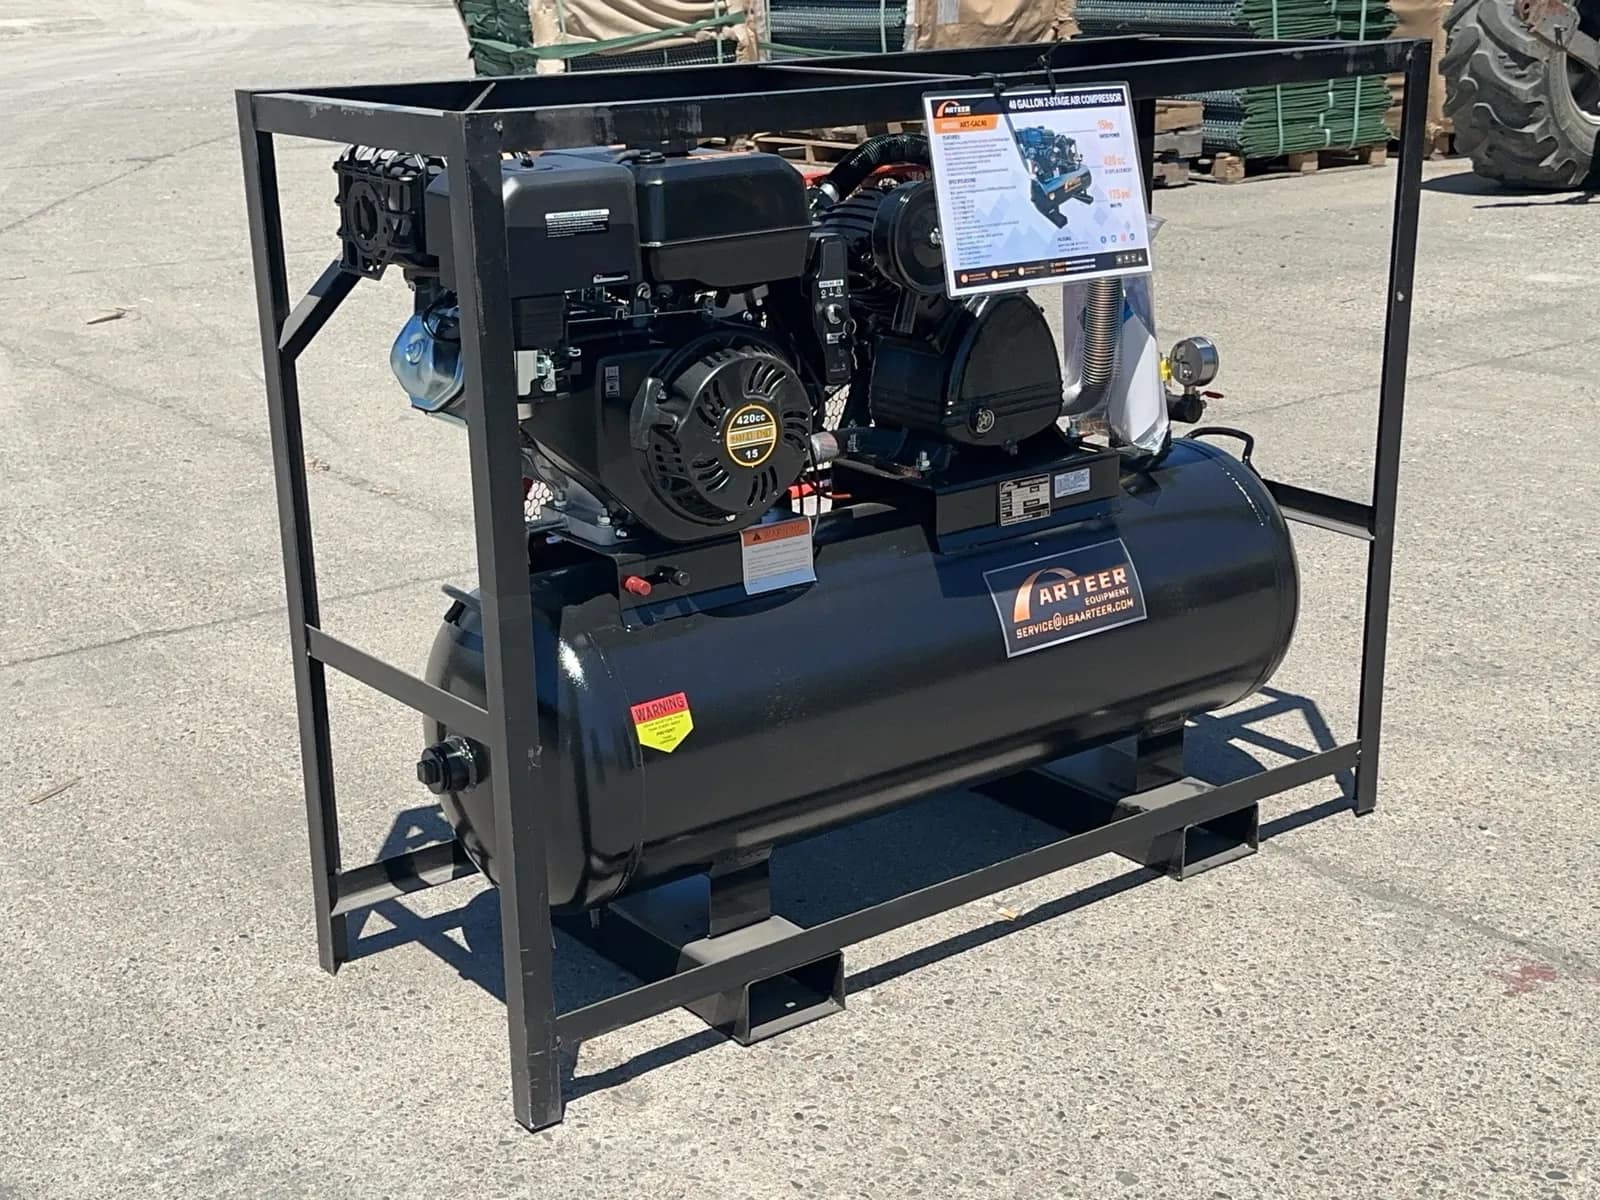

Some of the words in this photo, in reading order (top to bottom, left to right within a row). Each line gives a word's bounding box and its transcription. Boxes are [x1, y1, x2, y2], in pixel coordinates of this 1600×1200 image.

[1017, 96, 1044, 109] GALLON
[1070, 94, 1081, 105] AIR
[1081, 92, 1122, 105] COMPRESSOR
[736, 413, 766, 425] 420cc
[745, 449, 759, 459] 15
[1040, 567, 1127, 606] ARTEER
[1085, 587, 1130, 606] EQUIPMENT
[1016, 598, 1134, 639] SERVICE@USAARTEER.COM
[635, 696, 685, 721] WARNING
